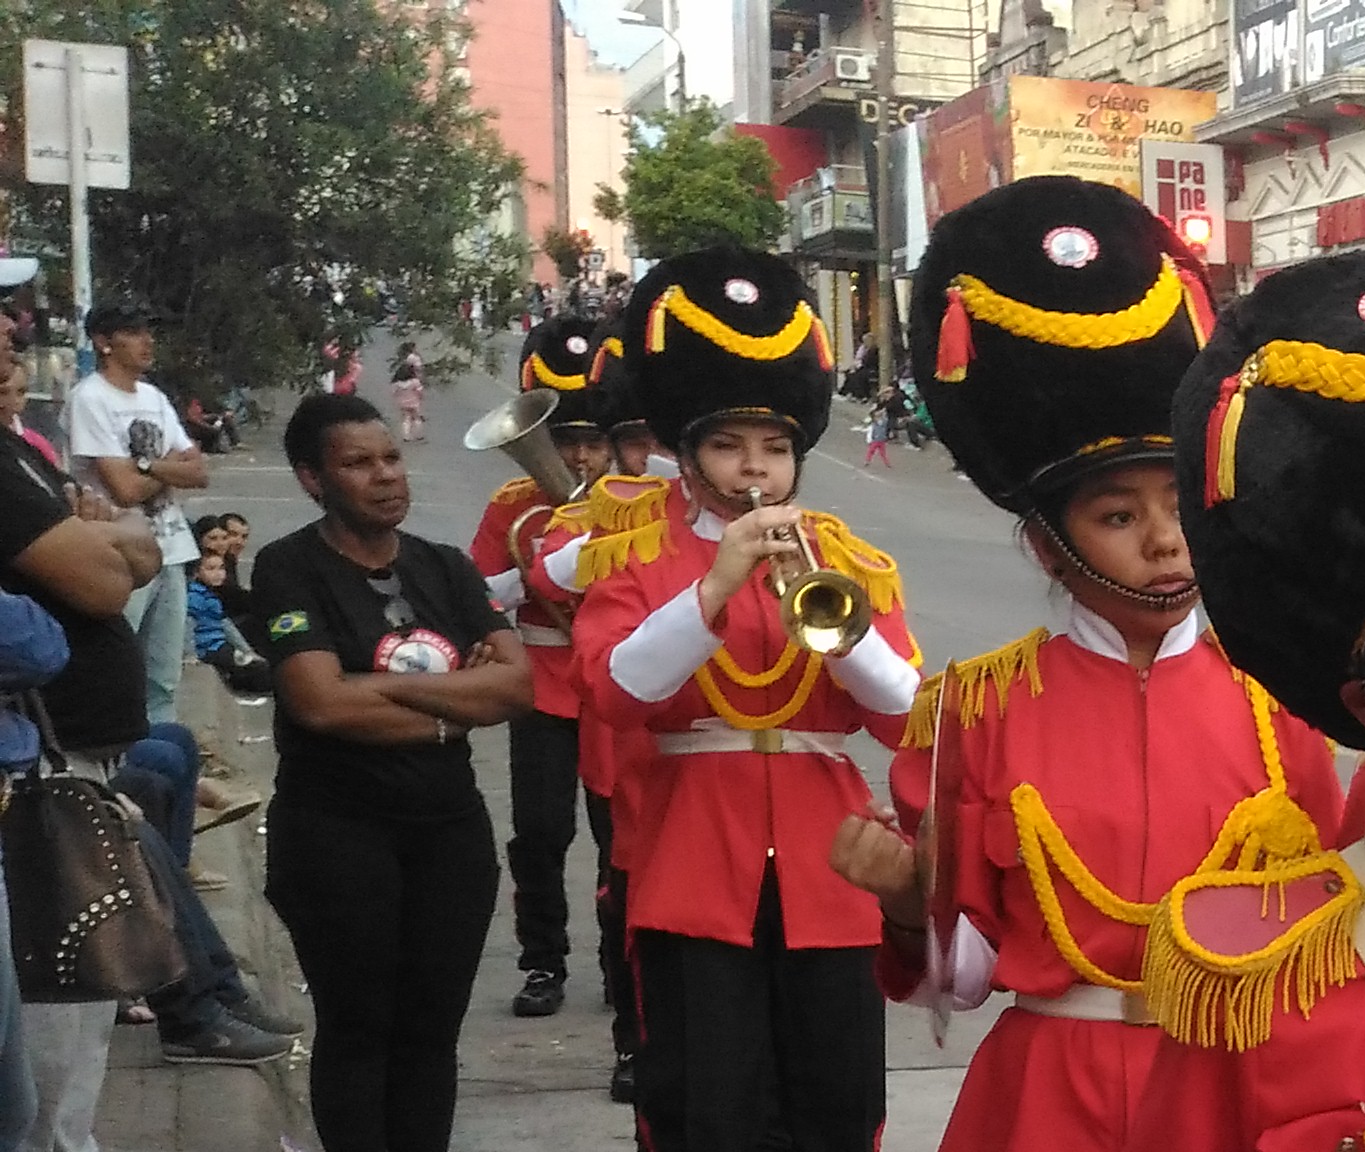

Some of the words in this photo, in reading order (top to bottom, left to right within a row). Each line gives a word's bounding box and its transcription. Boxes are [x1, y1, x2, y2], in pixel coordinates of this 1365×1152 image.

[1086, 94, 1150, 113] CHENG
[1018, 127, 1043, 138] POR
[1043, 128, 1084, 142] MAYOR
[1110, 116, 1126, 131] &
[1144, 119, 1184, 137] HAO
